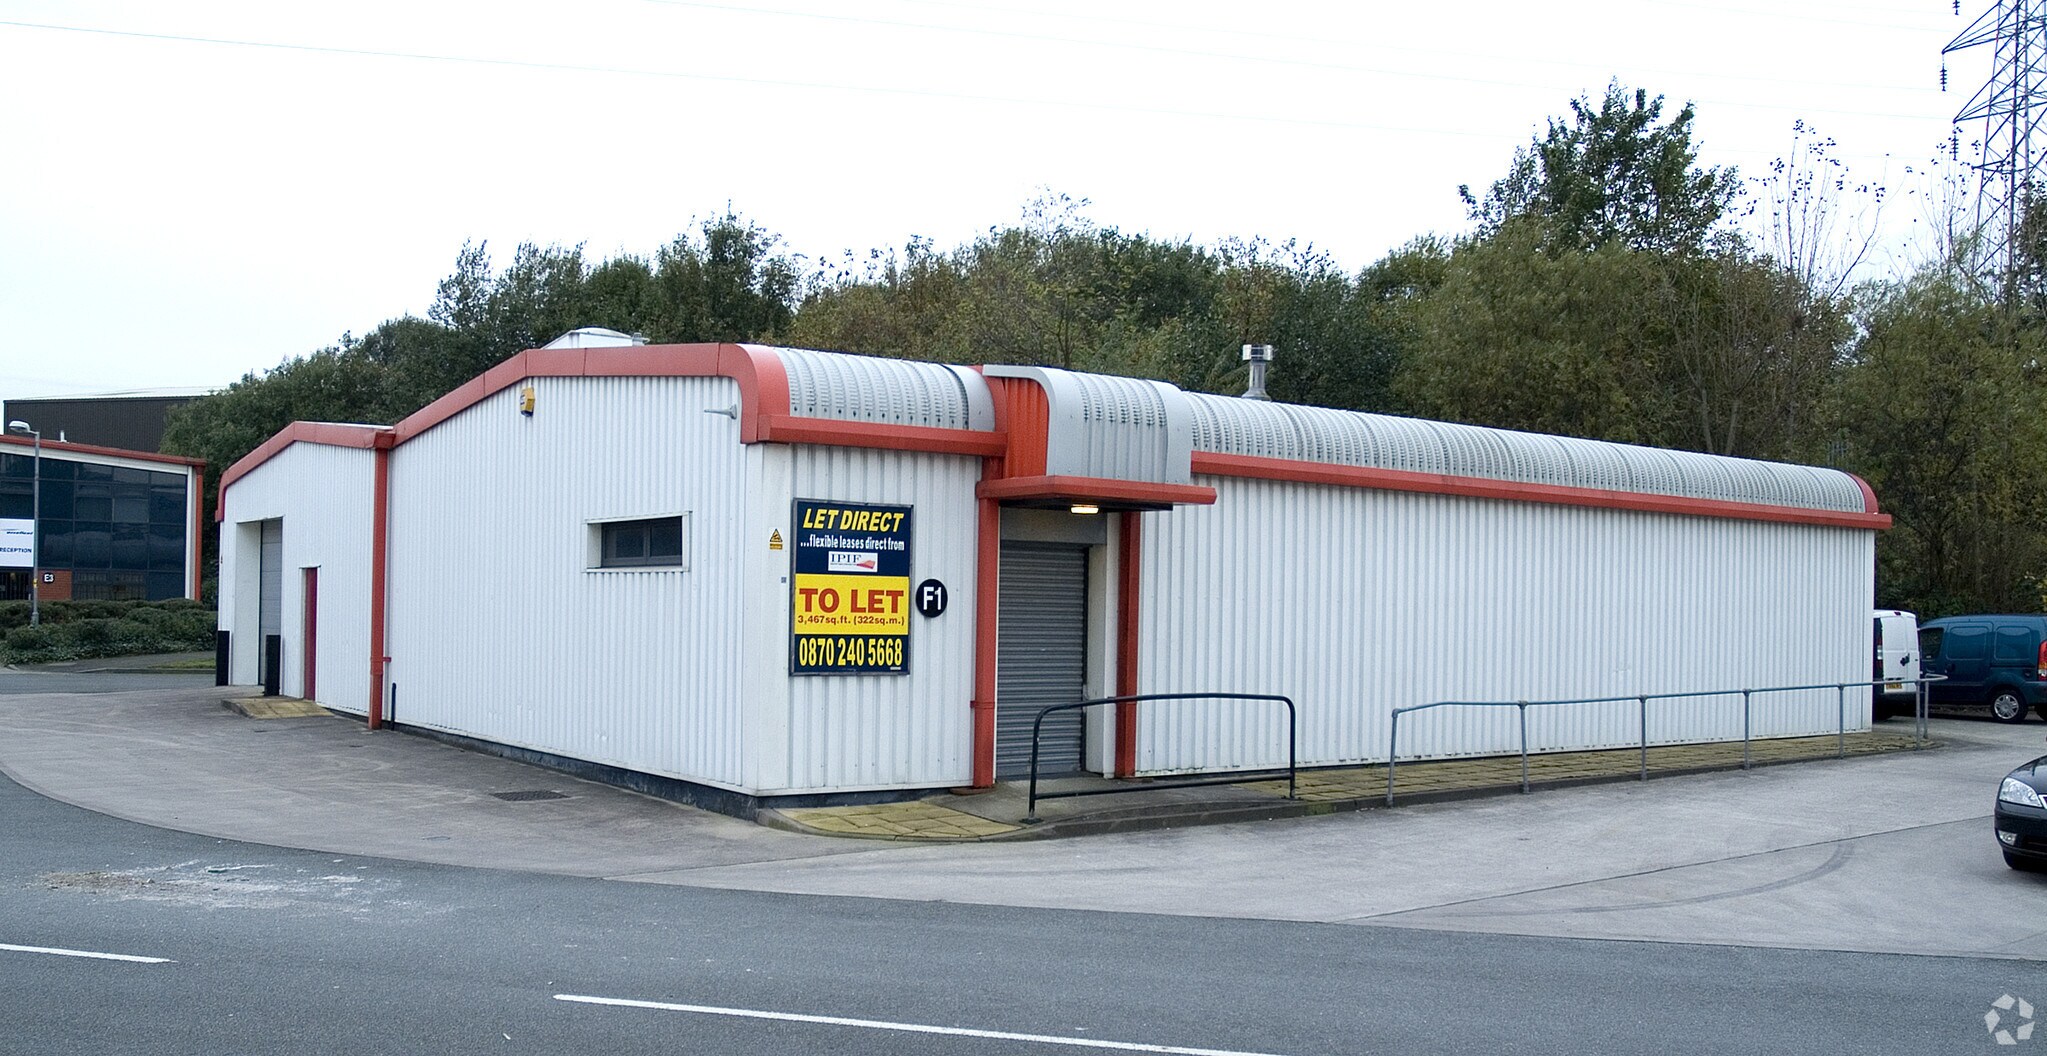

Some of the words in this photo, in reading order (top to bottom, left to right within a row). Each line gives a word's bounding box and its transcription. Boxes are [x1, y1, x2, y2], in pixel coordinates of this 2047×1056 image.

[803, 508, 839, 530] LET
[840, 510, 904, 533] DIRECT
[839, 535, 864, 549] leases
[865, 537, 887, 550] direct
[888, 537, 905, 551] from
[831, 553, 861, 563] IPIF
[799, 588, 840, 613] TO
[850, 589, 904, 613] LET
[923, 586, 942, 611] F1
[797, 615, 851, 625] 3,467sq.ft.
[853, 616, 905, 626] (322sq.m.)
[799, 637, 835, 667] 0870
[837, 637, 865, 667] 240
[867, 638, 902, 667] 5668
